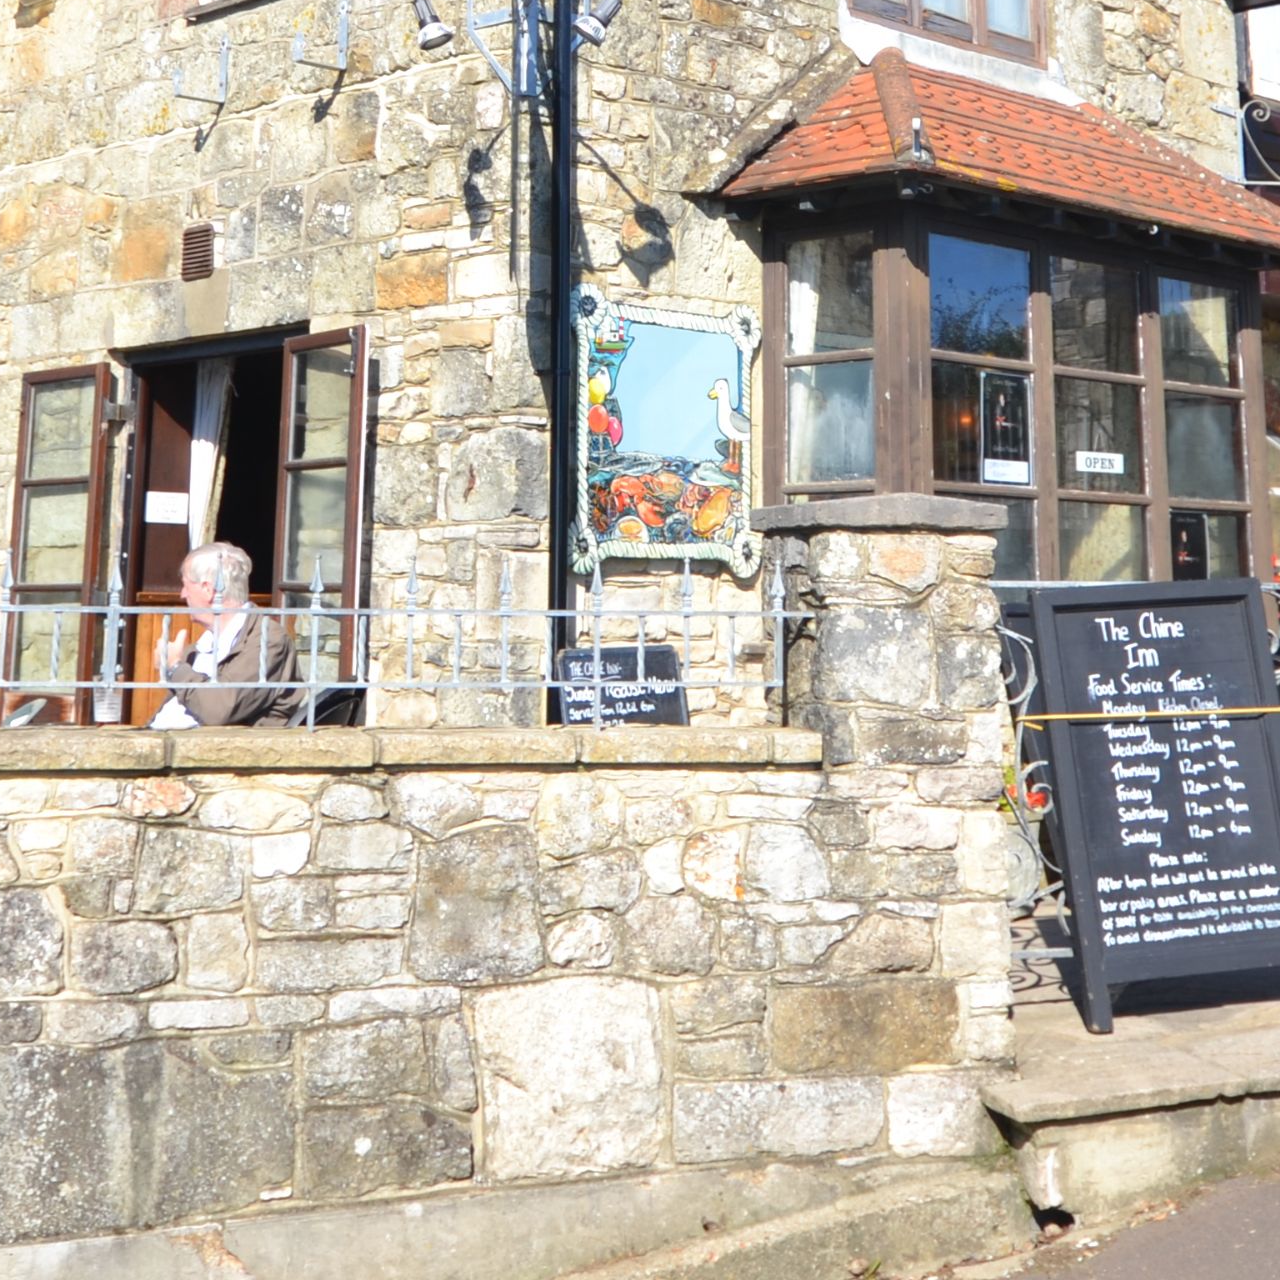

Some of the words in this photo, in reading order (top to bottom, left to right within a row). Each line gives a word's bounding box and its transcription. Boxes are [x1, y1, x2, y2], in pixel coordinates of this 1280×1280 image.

[1085, 456, 1116, 470] OPEN
[1094, 617, 1130, 642] The
[1138, 611, 1185, 639] Chine
[1124, 642, 1160, 669] Inn
[569, 661, 584, 676] THE
[1088, 673, 1118, 698] Food
[1121, 672, 1164, 695] Service
[1102, 699, 1146, 721] Monday
[1103, 723, 1151, 742] Tuesday
[1108, 738, 1170, 760] Wednesday
[1111, 760, 1160, 783] Thursday
[1115, 784, 1152, 804] Friday
[1117, 805, 1168, 823] Saturday
[1120, 828, 1162, 848] Sunday
[1149, 852, 1180, 868] Please
[1183, 851, 1208, 865] note:
[1097, 877, 1123, 893] After
[1151, 872, 1170, 888] food
[1171, 872, 1187, 885] will
[1188, 870, 1205, 883] not
[1206, 867, 1218, 881] be
[1248, 862, 1259, 876] in
[1259, 863, 1277, 875] the
[1100, 898, 1118, 913] bar
[1119, 899, 1129, 912] or
[1130, 897, 1155, 914] patio
[1189, 888, 1218, 904] Please
[1238, 889, 1247, 900] a
[1102, 917, 1114, 931] of
[1140, 913, 1152, 926] for
[1221, 906, 1230, 915] in
[1103, 931, 1116, 947] To
[1117, 932, 1140, 945] avoid
[1208, 924, 1216, 935] is
[1254, 918, 1264, 930] to
